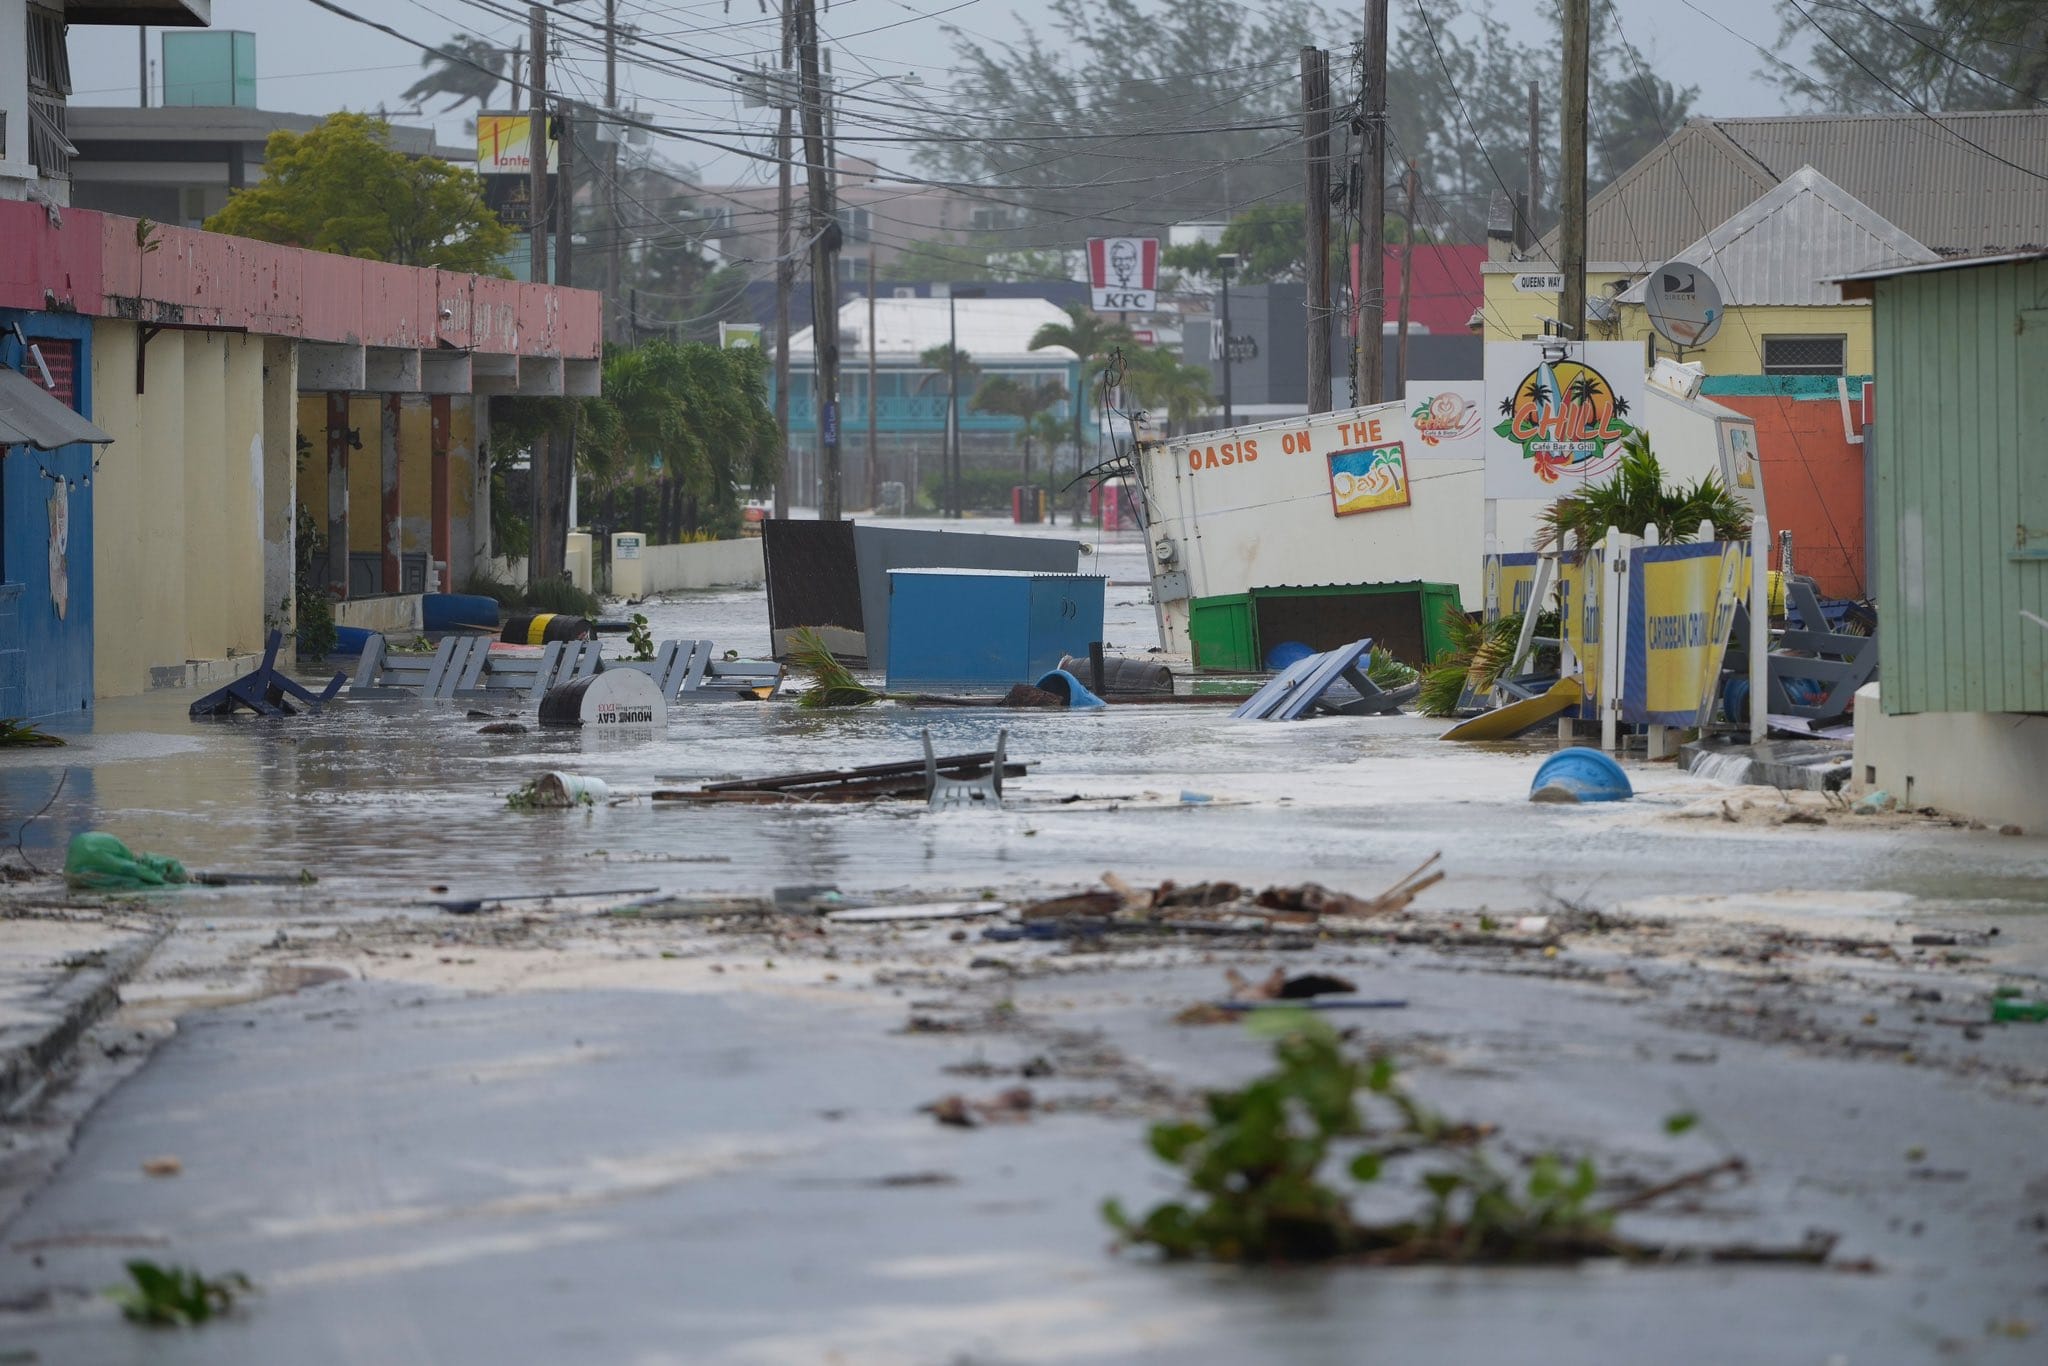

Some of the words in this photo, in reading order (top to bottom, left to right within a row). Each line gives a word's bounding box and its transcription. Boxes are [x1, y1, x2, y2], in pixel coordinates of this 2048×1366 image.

[1521, 276, 1546, 289] QUEENS
[1547, 275, 1561, 288] WAY
[1104, 293, 1147, 308] KFC
[1512, 402, 1622, 440] CHILL
[1188, 439, 1258, 471] OASIS
[1281, 430, 1312, 455] ON
[1337, 419, 1383, 447] THE
[1552, 442, 1567, 451] Bar
[1569, 442, 1575, 451] &
[1577, 442, 1595, 451] Grill
[1334, 465, 1390, 499] Oasis
[1649, 613, 1688, 651] CARIBBEAN
[597, 712, 616, 724] GAY
[618, 711, 652, 723] MOUNT
